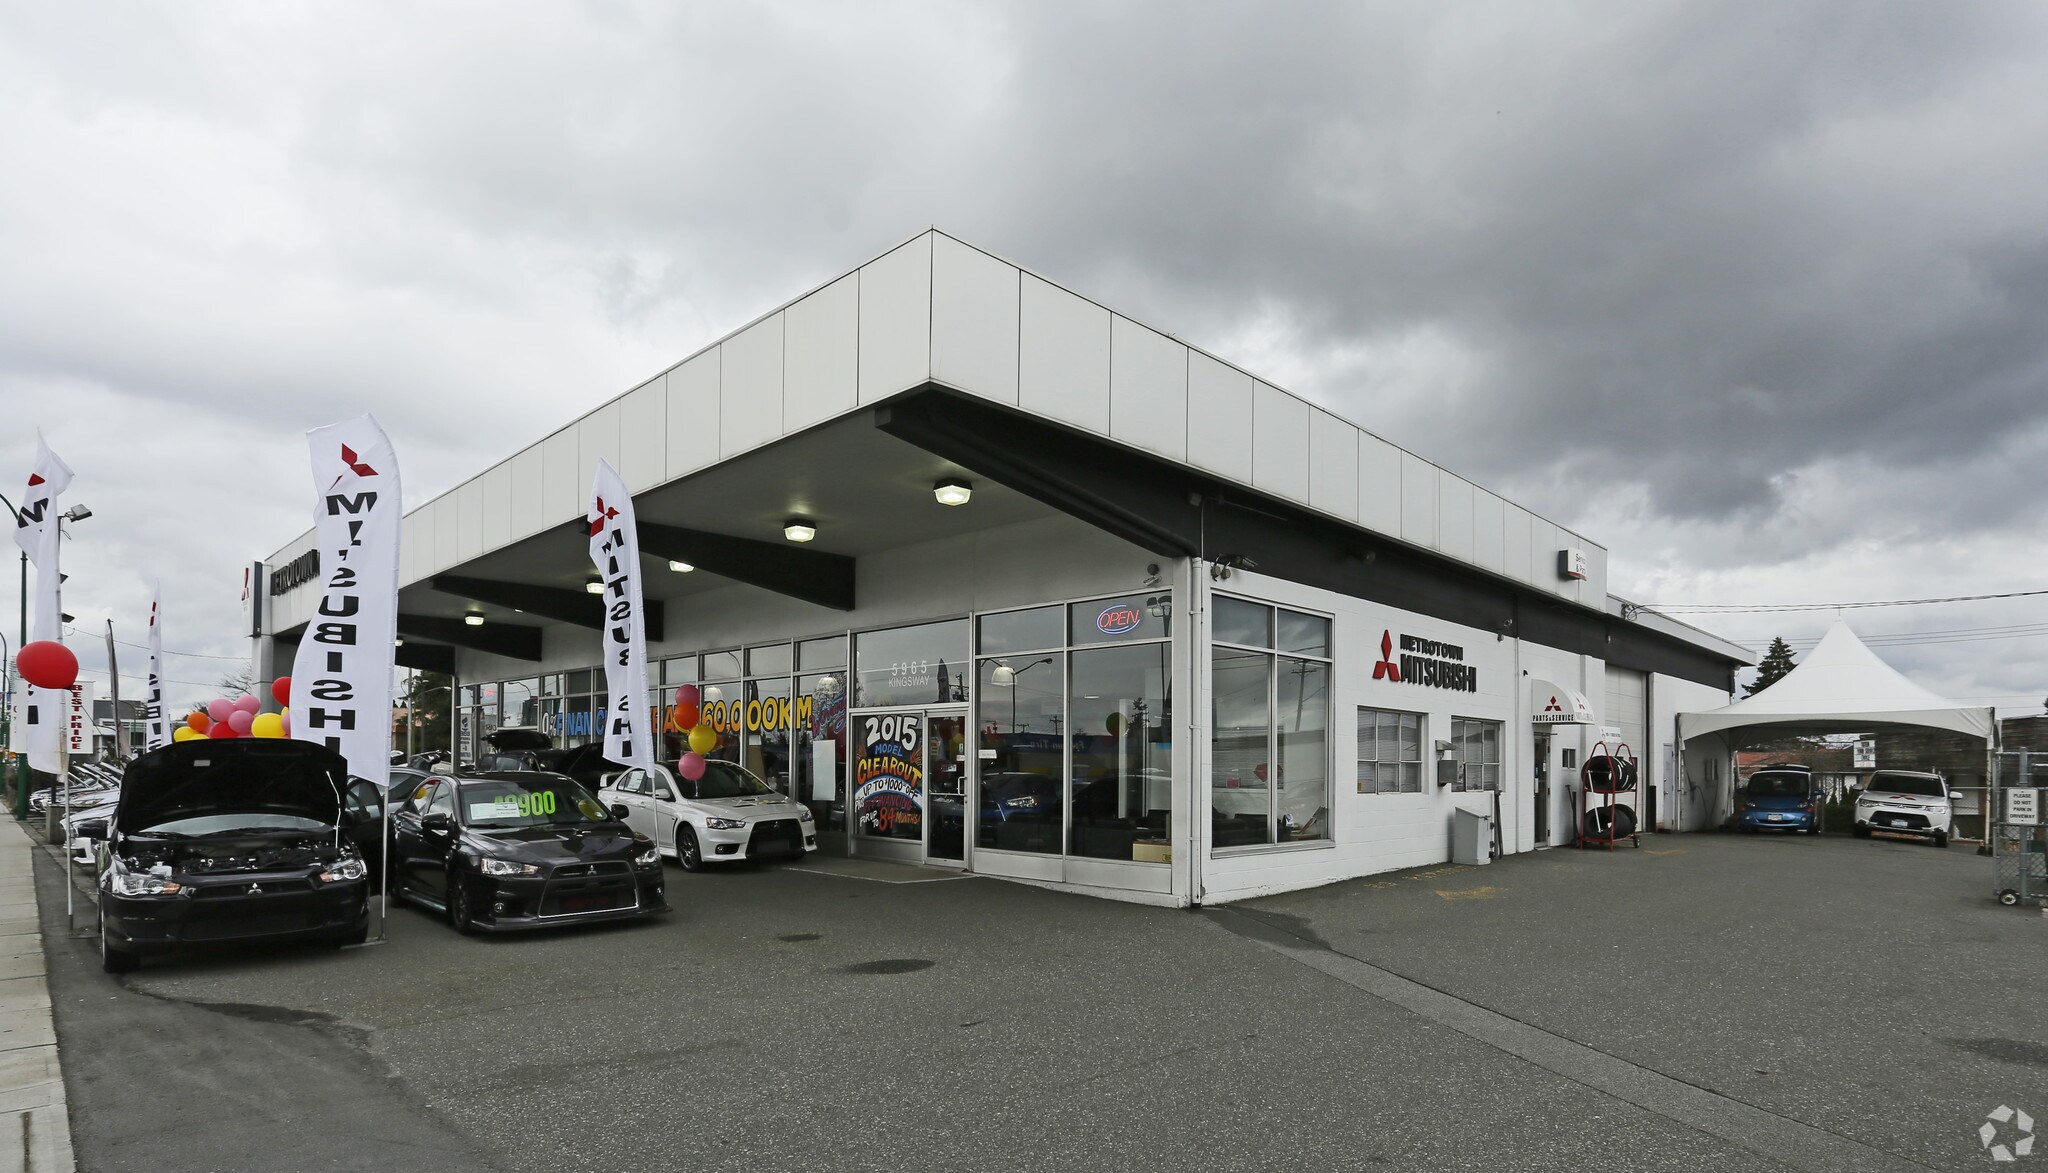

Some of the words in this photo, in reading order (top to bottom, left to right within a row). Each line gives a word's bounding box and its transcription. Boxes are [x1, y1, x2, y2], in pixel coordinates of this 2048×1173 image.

[1099, 609, 1140, 628] OPEN
[1400, 634, 1464, 661] METROTOWN
[888, 675, 930, 687] KINGSWAY
[892, 660, 927, 676] 5965
[1400, 654, 1477, 694] MITSUBISHI
[70, 684, 83, 712] BEST
[70, 715, 83, 750] PRICE
[865, 715, 919, 751] 2015
[875, 743, 903, 757] MODEL
[857, 756, 922, 788] CLEAROUT
[863, 783, 872, 796] UP
[873, 779, 884, 791] TO
[905, 785, 918, 800] OFF
[879, 806, 896, 831] 84
